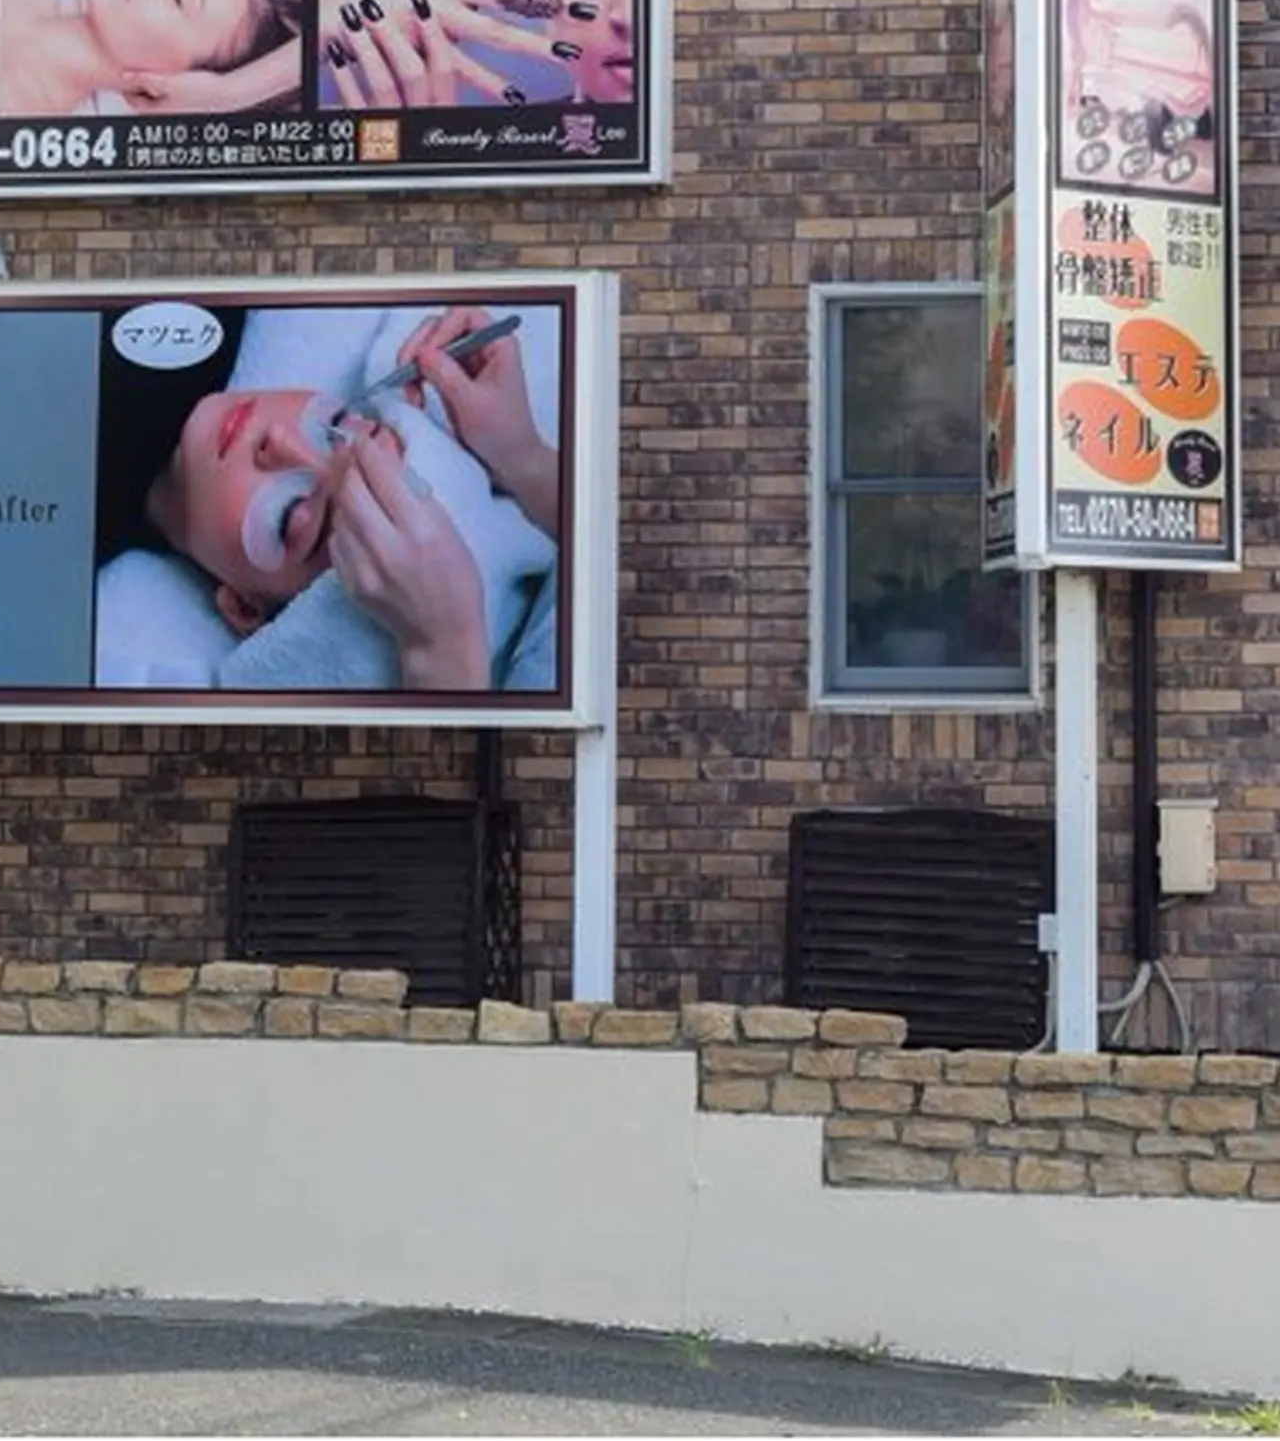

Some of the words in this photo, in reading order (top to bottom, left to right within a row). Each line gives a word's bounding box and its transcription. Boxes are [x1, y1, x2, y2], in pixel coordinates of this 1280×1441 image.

[1082, 199, 1136, 244] 整体
[1167, 208, 1220, 238] 男性も
[1056, 251, 1164, 302] 骨盤矯正
[122, 324, 219, 347] マツエク
[1118, 352, 1216, 394] エステ
[1062, 413, 1161, 455] ネイル
